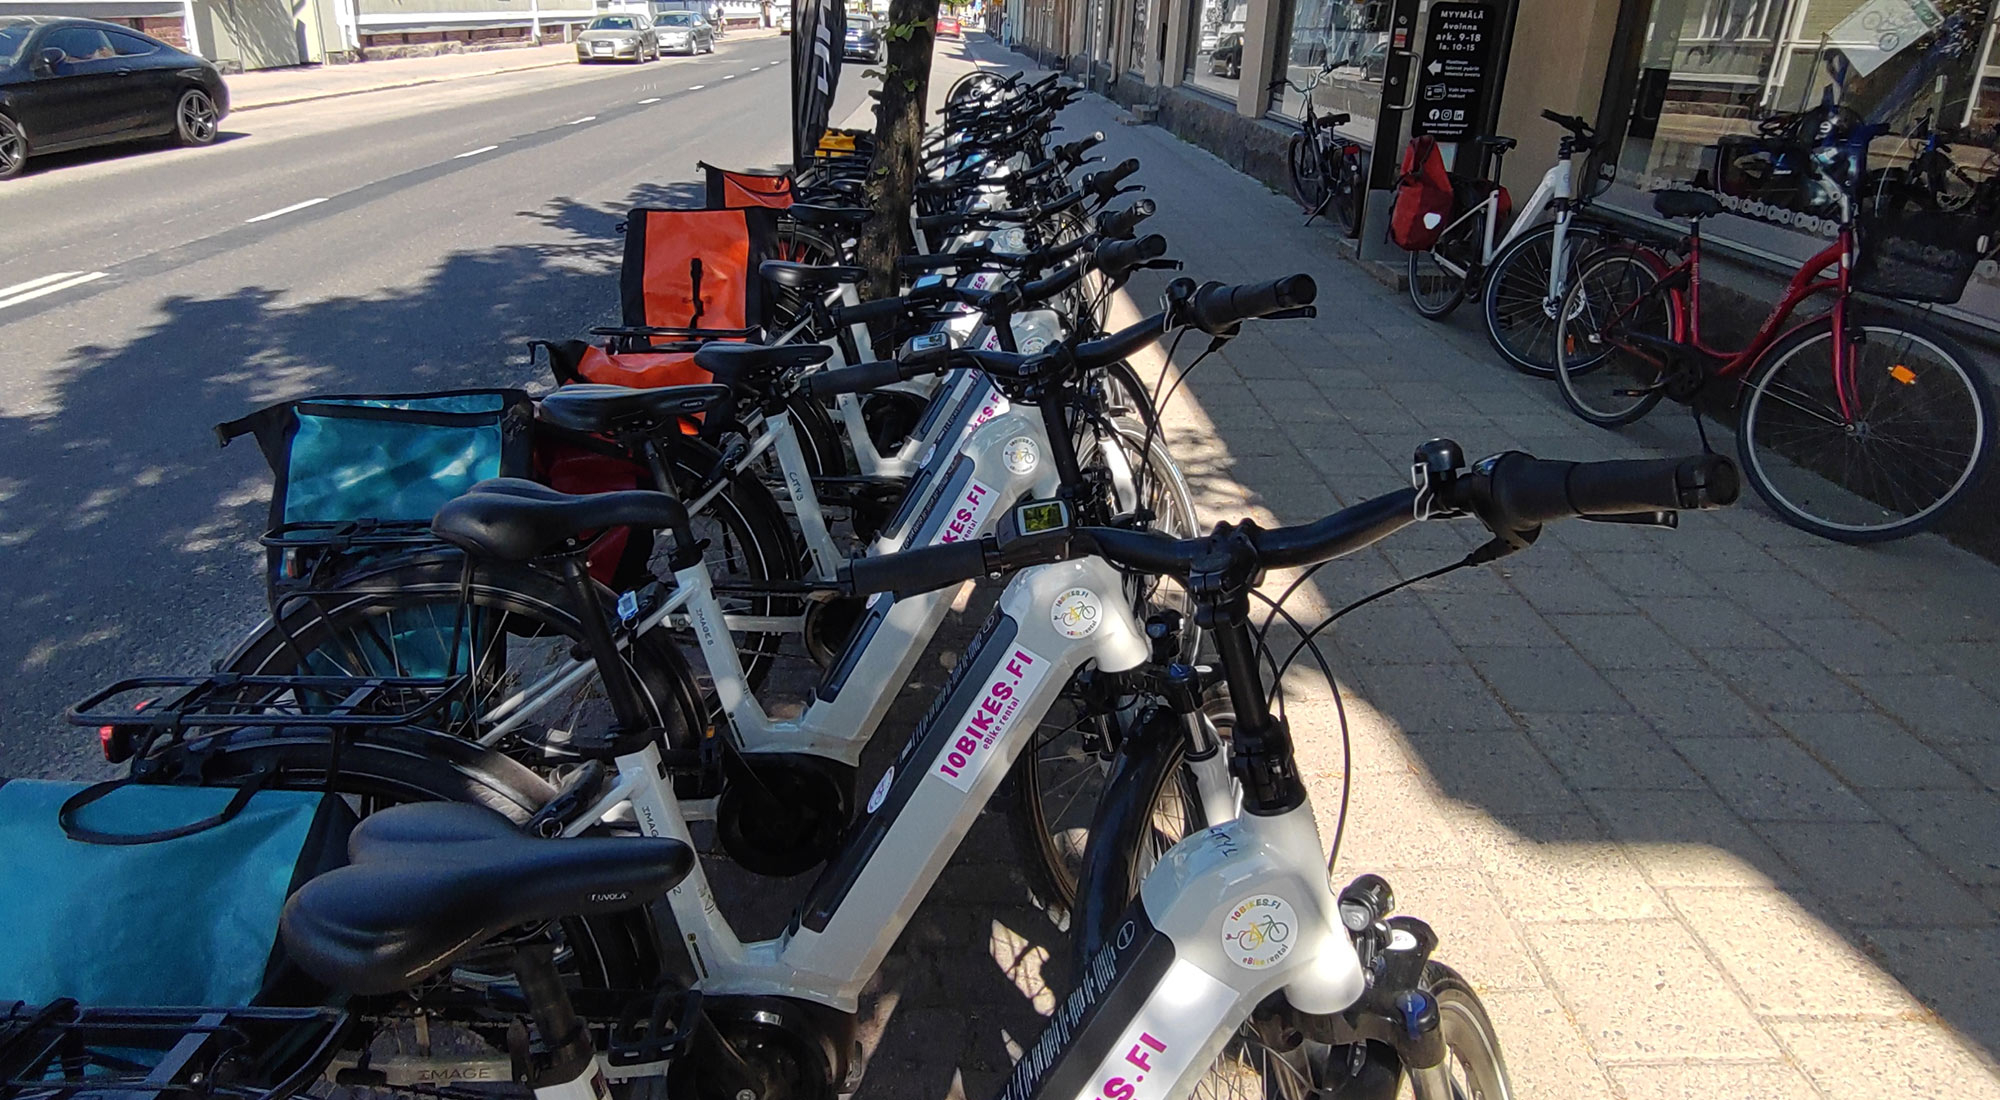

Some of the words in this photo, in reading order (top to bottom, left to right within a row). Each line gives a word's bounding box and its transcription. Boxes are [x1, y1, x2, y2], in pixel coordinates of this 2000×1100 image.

[1440, 10, 1484, 19] MYYMÄLÄ
[1443, 22, 1477, 31] Avoinna
[1435, 32, 1456, 41] ark.
[1459, 33, 1481, 42] 9-18
[940, 485, 986, 544] KES.FI
[940, 650, 1034, 778] 10BIKES.FI
[983, 726, 1001, 750] eBike
[999, 696, 1020, 725] rental
[642, 805, 659, 837] IMAG
[1231, 898, 1281, 921] 10BIKES.FI
[418, 1067, 492, 1081] IMAGE
[1100, 1032, 1167, 1100] S.FI
